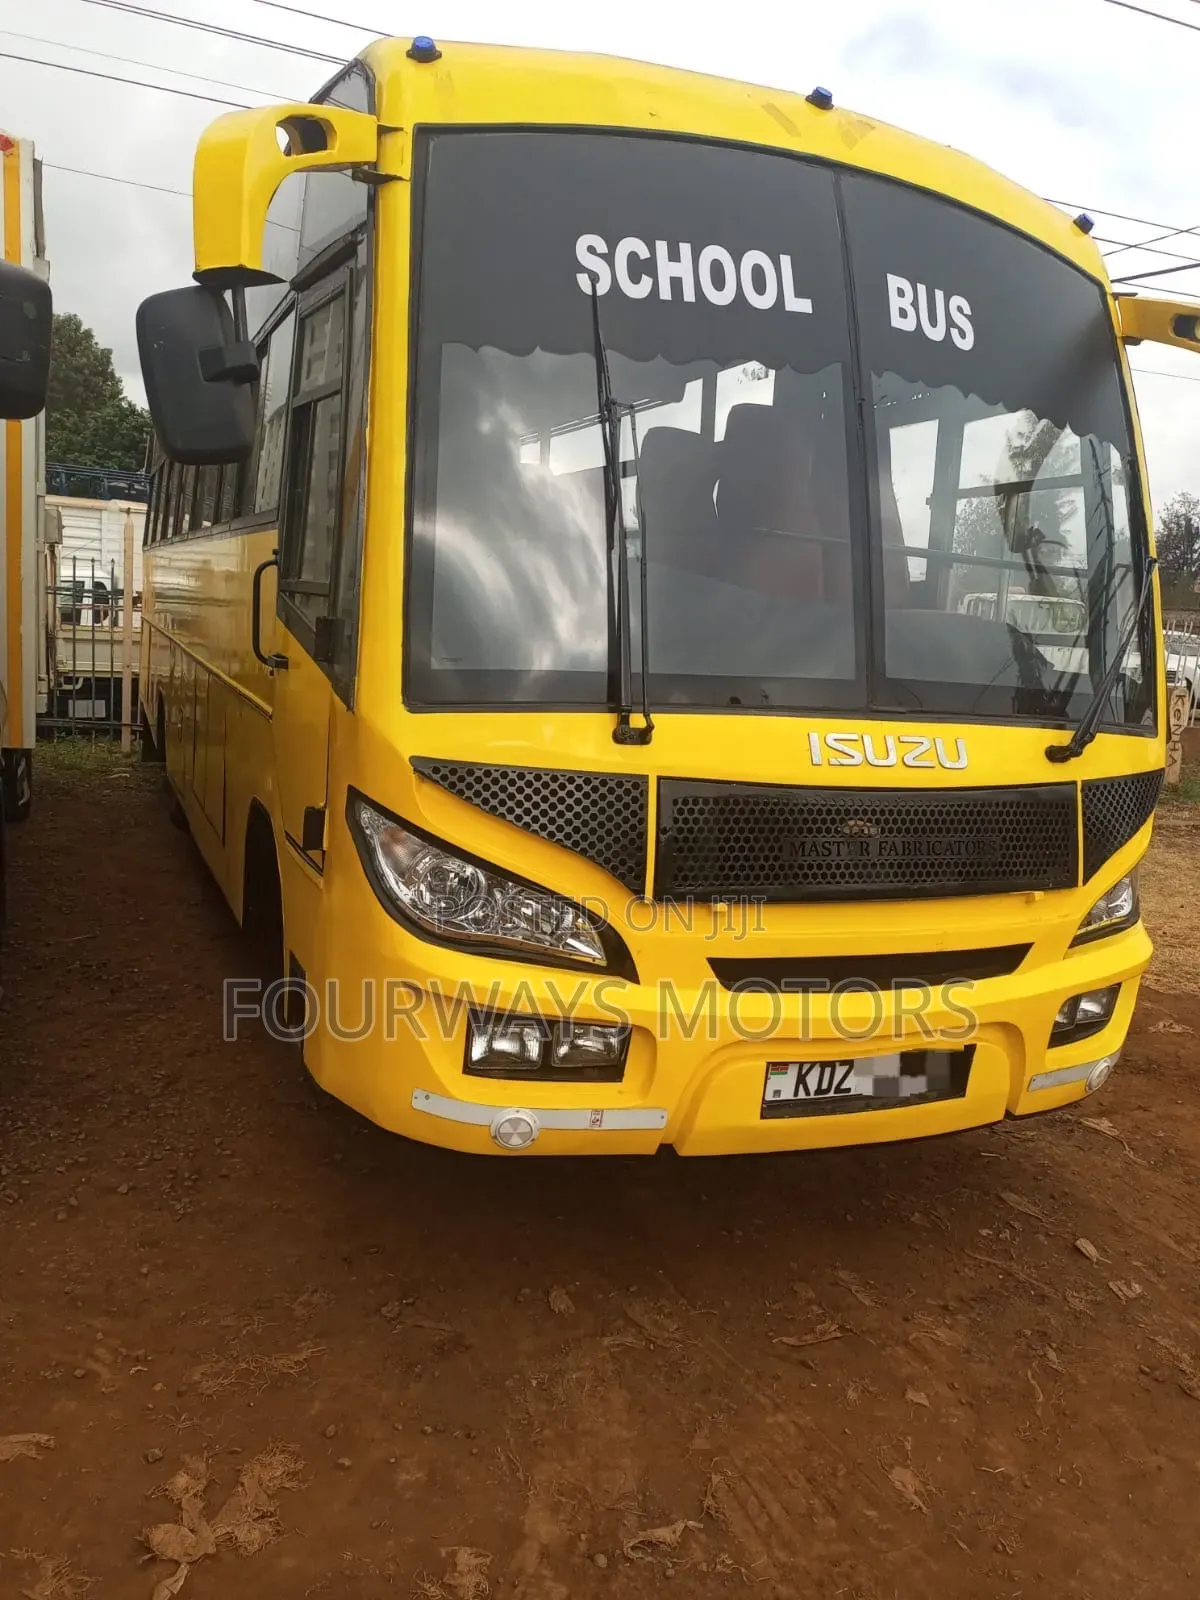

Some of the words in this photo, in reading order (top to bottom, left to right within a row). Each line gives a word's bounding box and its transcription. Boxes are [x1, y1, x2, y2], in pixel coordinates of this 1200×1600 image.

[575, 233, 813, 314] SCHOOL
[886, 272, 975, 351] BUS
[807, 732, 968, 769] ISUZU
[878, 839, 998, 857] FABRICATORS
